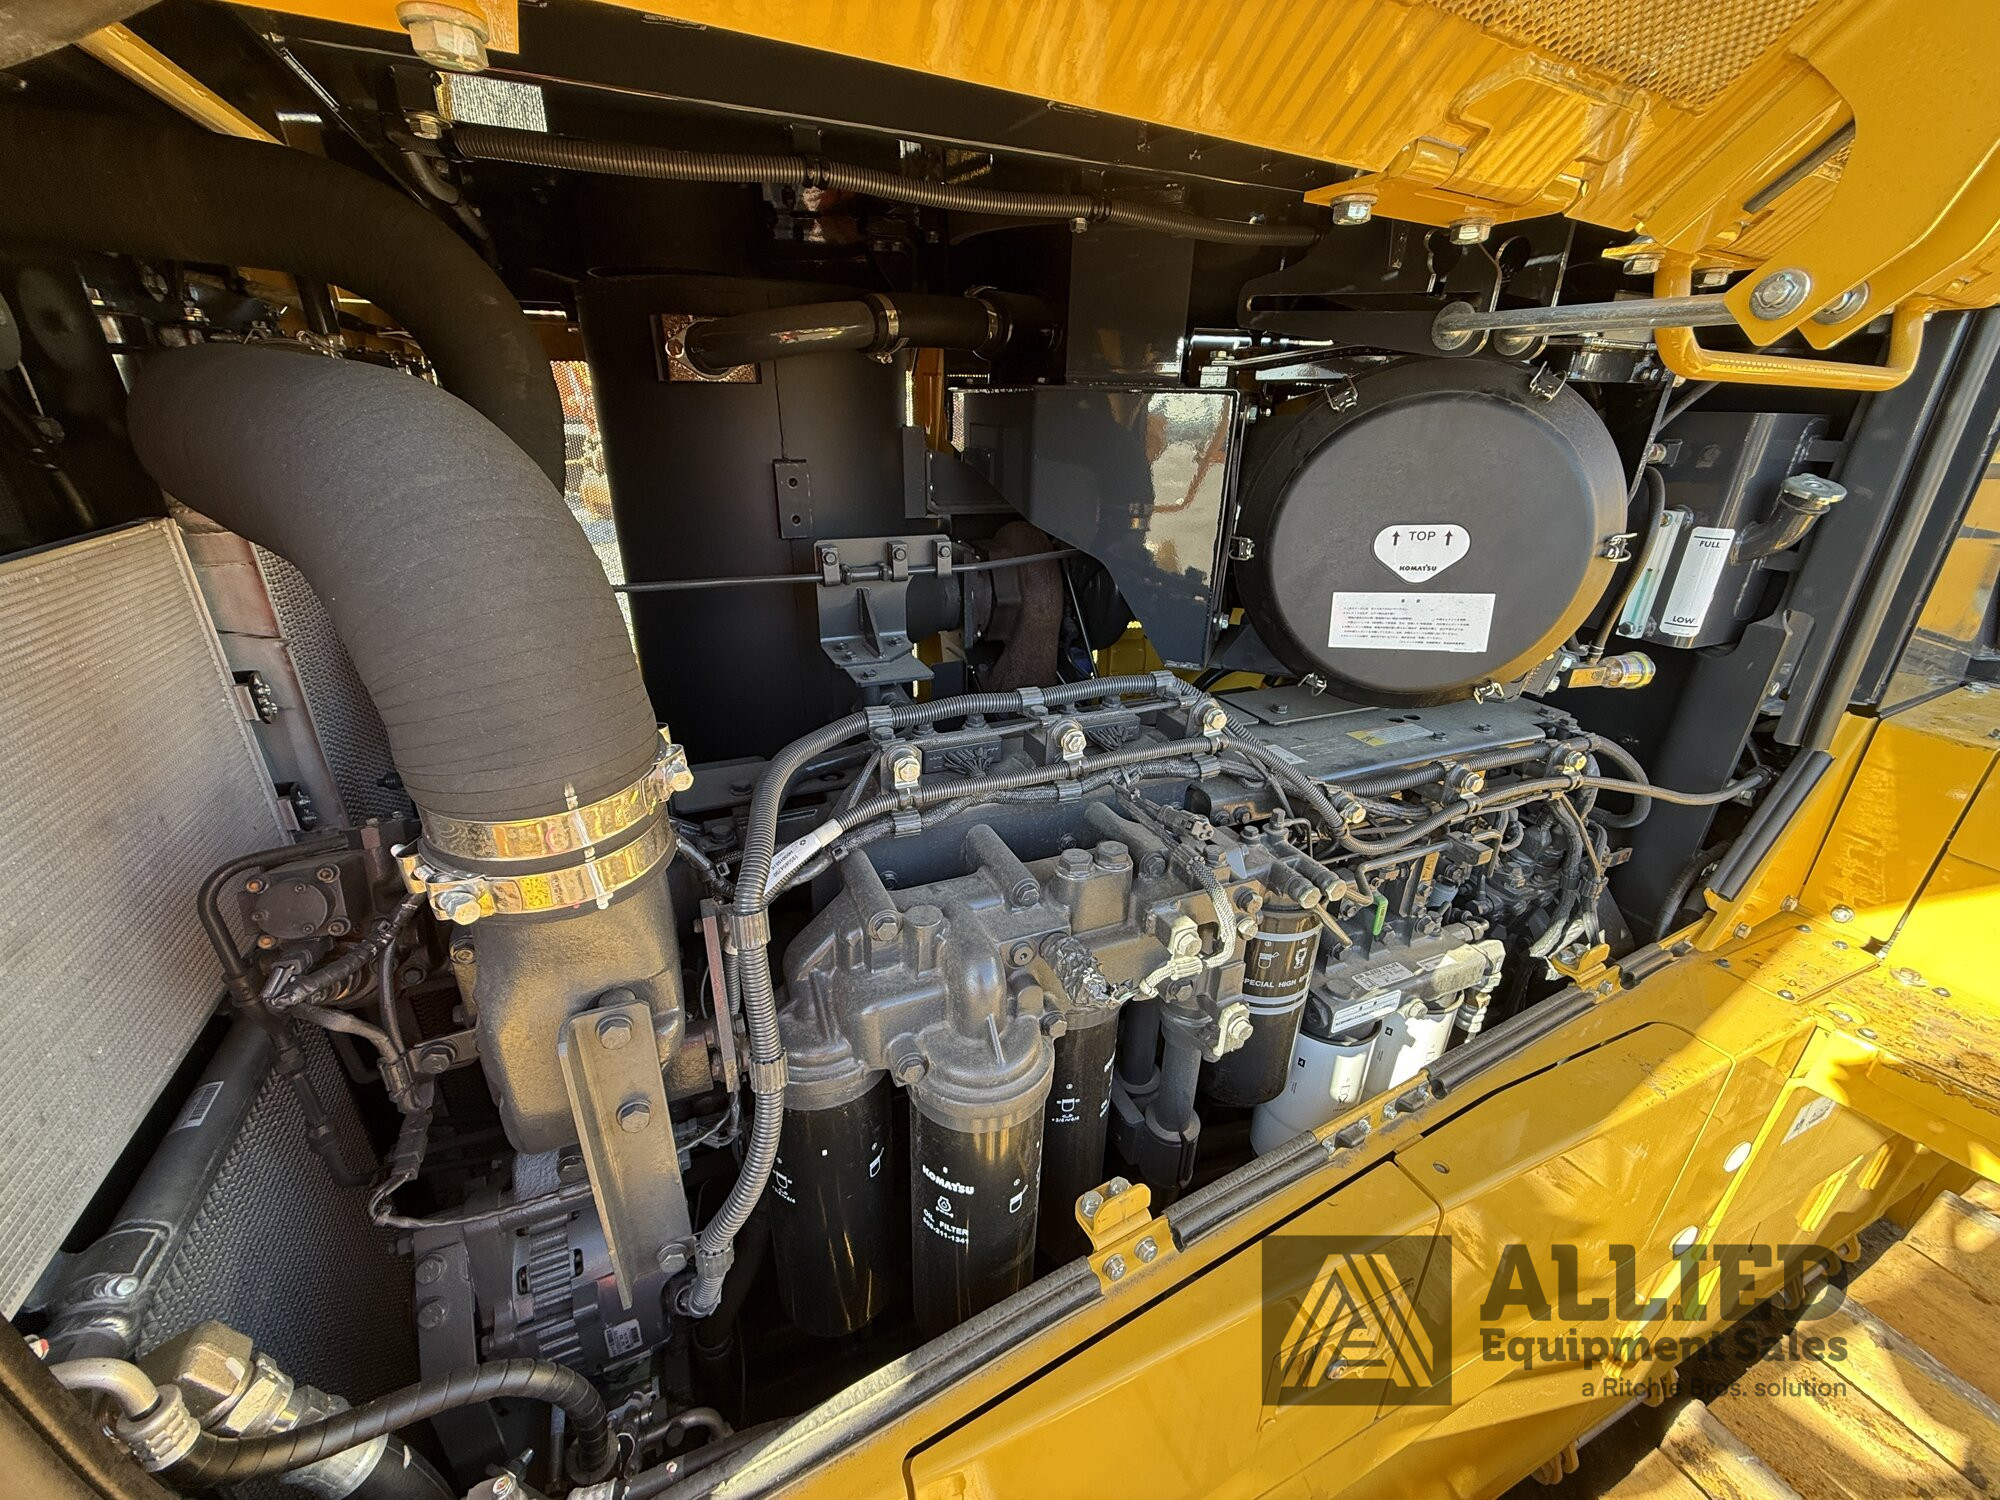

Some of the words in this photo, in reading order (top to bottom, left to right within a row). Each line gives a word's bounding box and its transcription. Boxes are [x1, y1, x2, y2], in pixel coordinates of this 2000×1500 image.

[1409, 531, 1436, 541] TOP
[1699, 540, 1720, 548] FULL
[1673, 615, 1695, 624] LOW
[1244, 978, 1274, 988] PECIAL
[1278, 979, 1297, 988] HIGH
[922, 1164, 975, 1195] KOMATSU
[923, 1208, 935, 1222] OIL
[940, 1220, 969, 1236] FILTER
